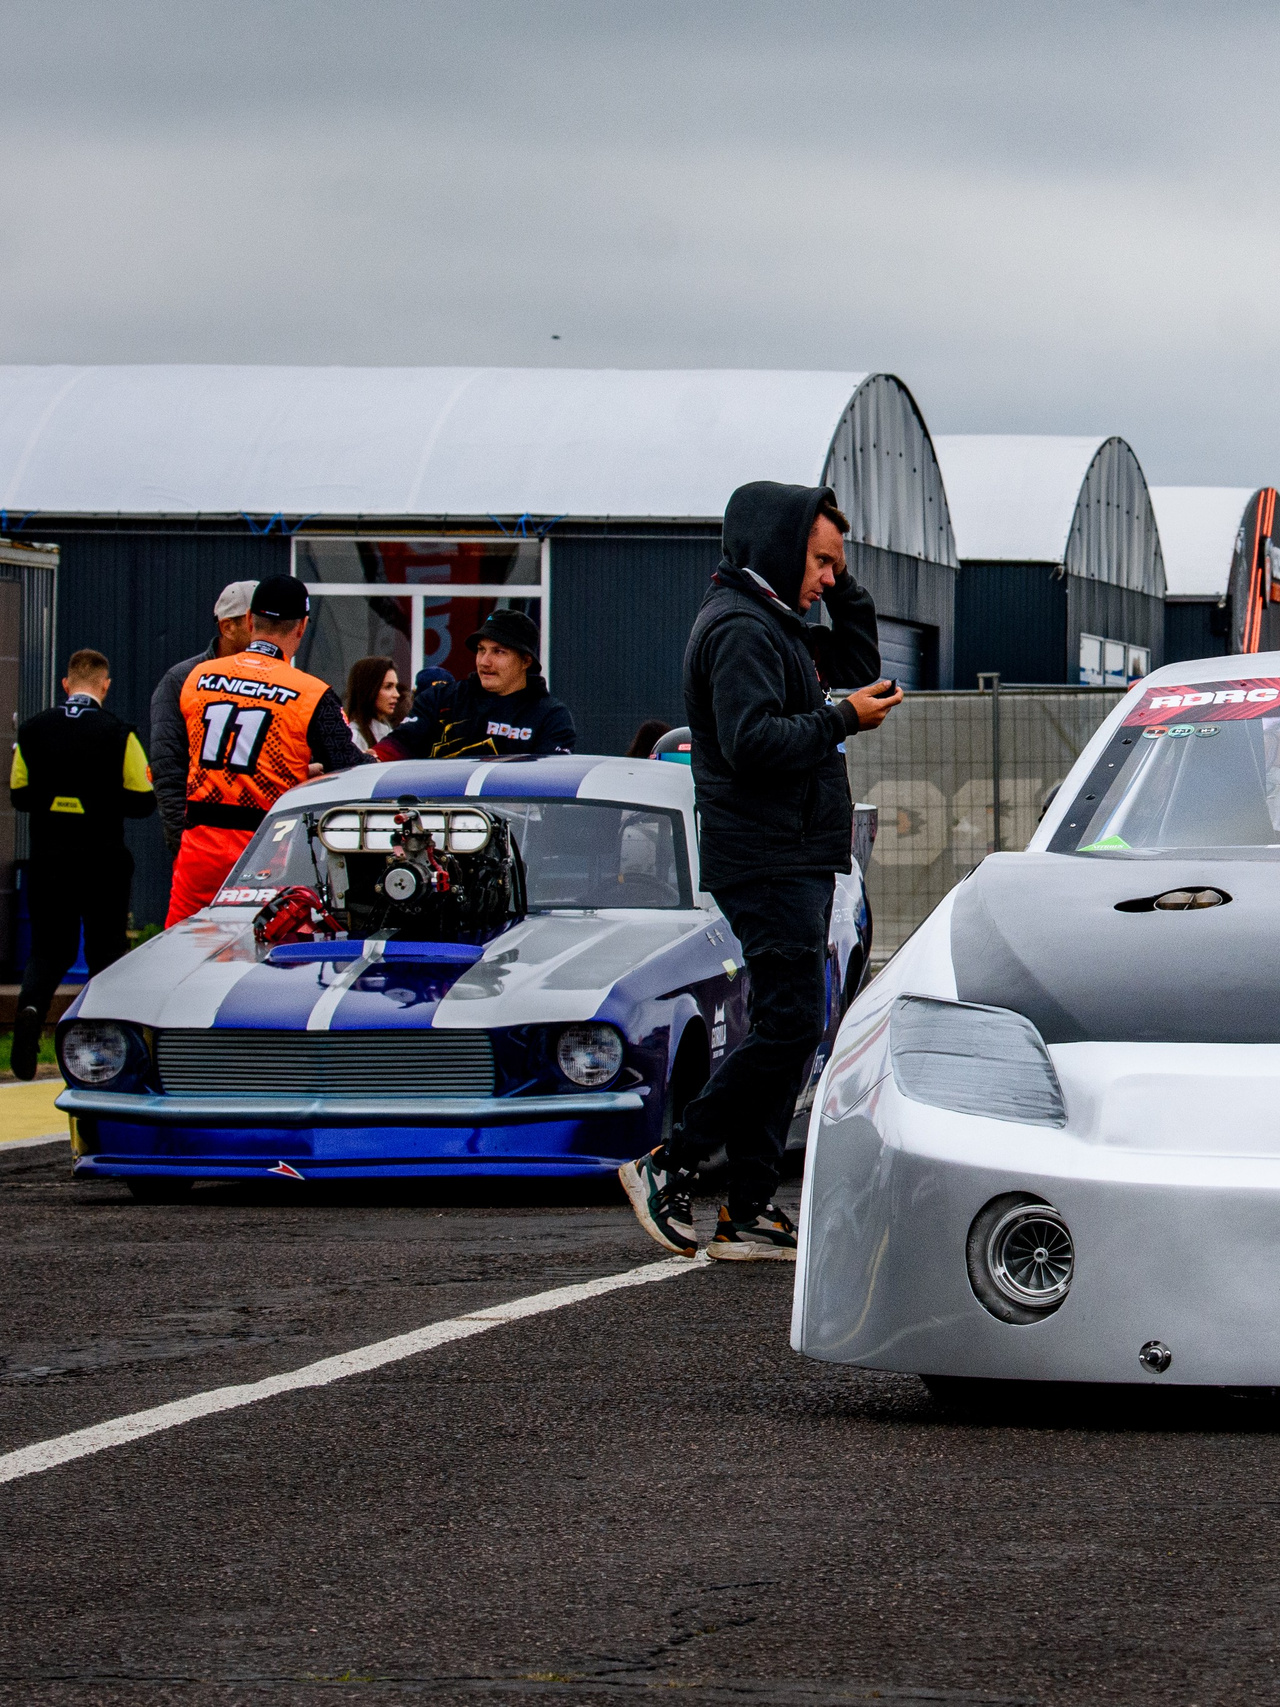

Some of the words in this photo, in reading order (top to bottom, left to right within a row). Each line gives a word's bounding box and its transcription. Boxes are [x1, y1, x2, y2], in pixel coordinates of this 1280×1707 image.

[197, 674, 299, 704] K.NIGHT
[1149, 688, 1280, 709] RDRC
[201, 702, 268, 769] 11
[486, 721, 532, 740] RDRC
[272, 819, 297, 842] 7
[216, 888, 281, 902] RDR
